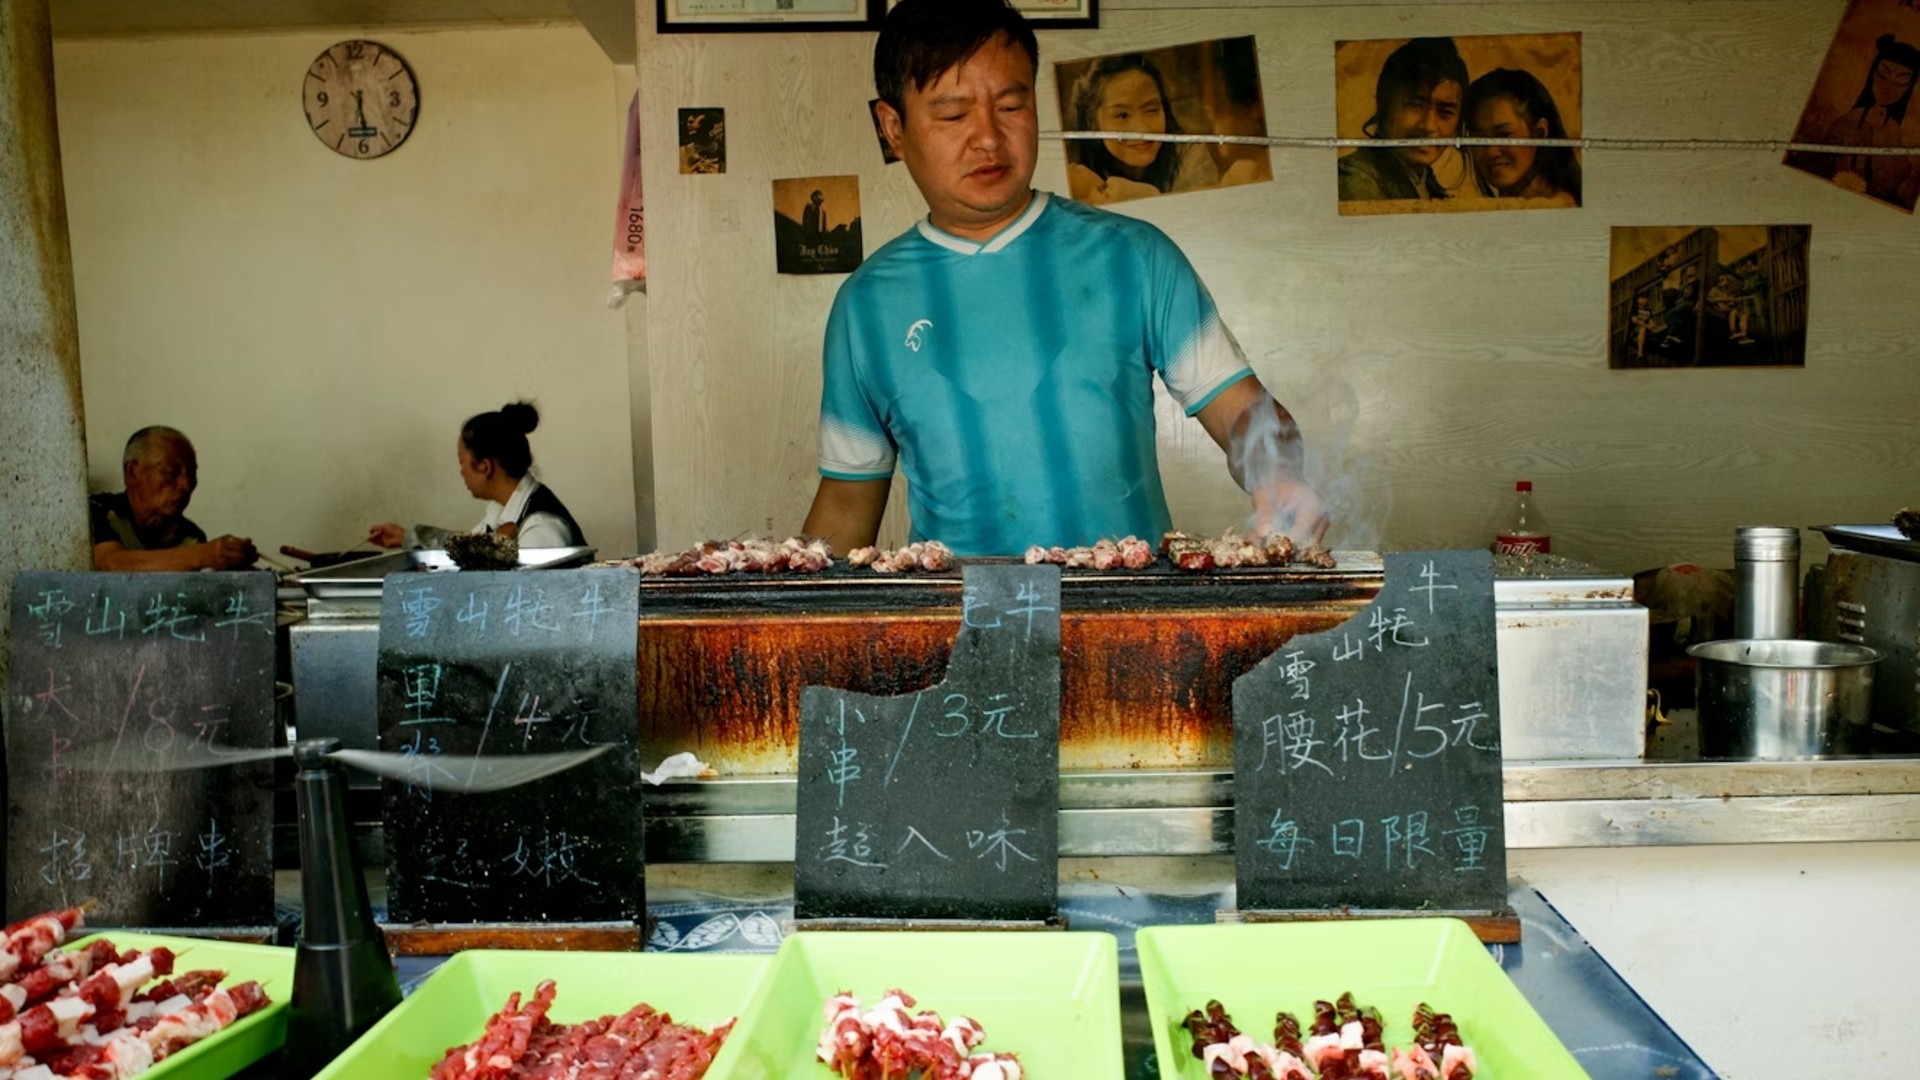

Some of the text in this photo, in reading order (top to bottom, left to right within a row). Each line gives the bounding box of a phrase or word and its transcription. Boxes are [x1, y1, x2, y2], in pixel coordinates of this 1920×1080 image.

[346, 43, 364, 60] 12
[317, 91, 329, 108] 9
[389, 91, 401, 107] 3
[358, 139, 369, 154] 6
[820, 808, 1038, 873] 超入味
[1255, 804, 1495, 872] 每日限量
